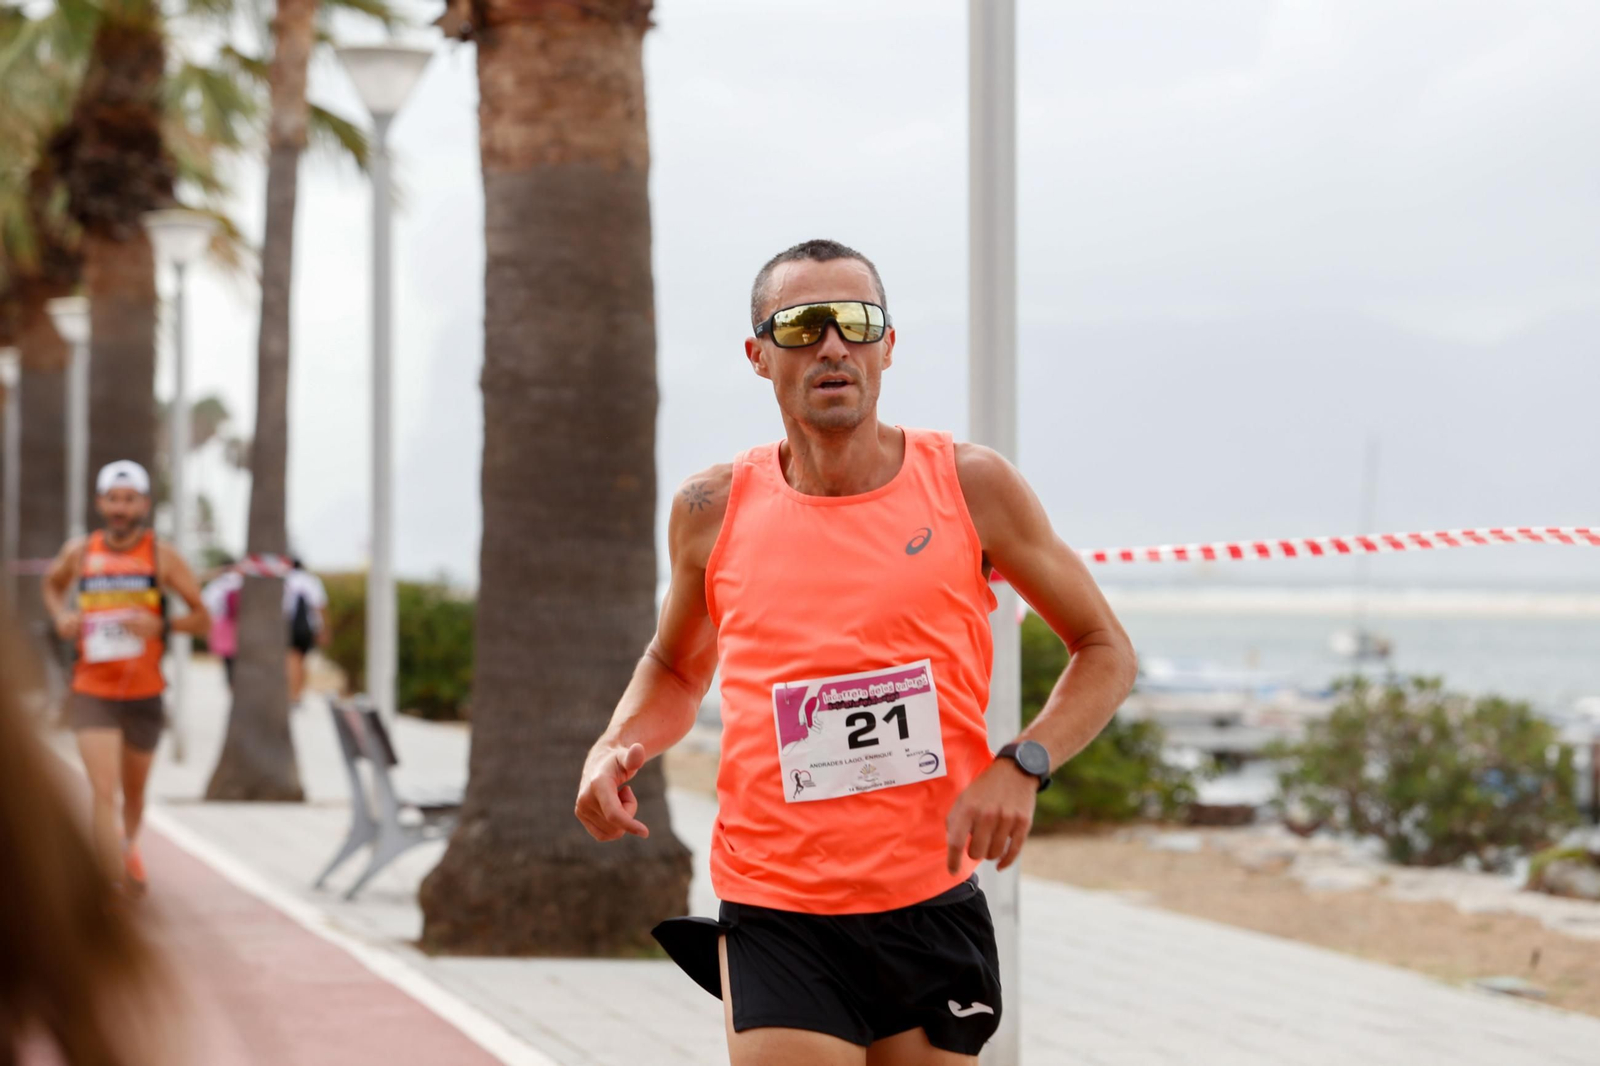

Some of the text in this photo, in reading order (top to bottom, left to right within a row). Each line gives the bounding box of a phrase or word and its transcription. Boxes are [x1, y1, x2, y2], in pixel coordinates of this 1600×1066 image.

[846, 704, 909, 750] 21
[809, 760, 843, 769] ANDRADES
[865, 751, 893, 761] ENRIQUE
